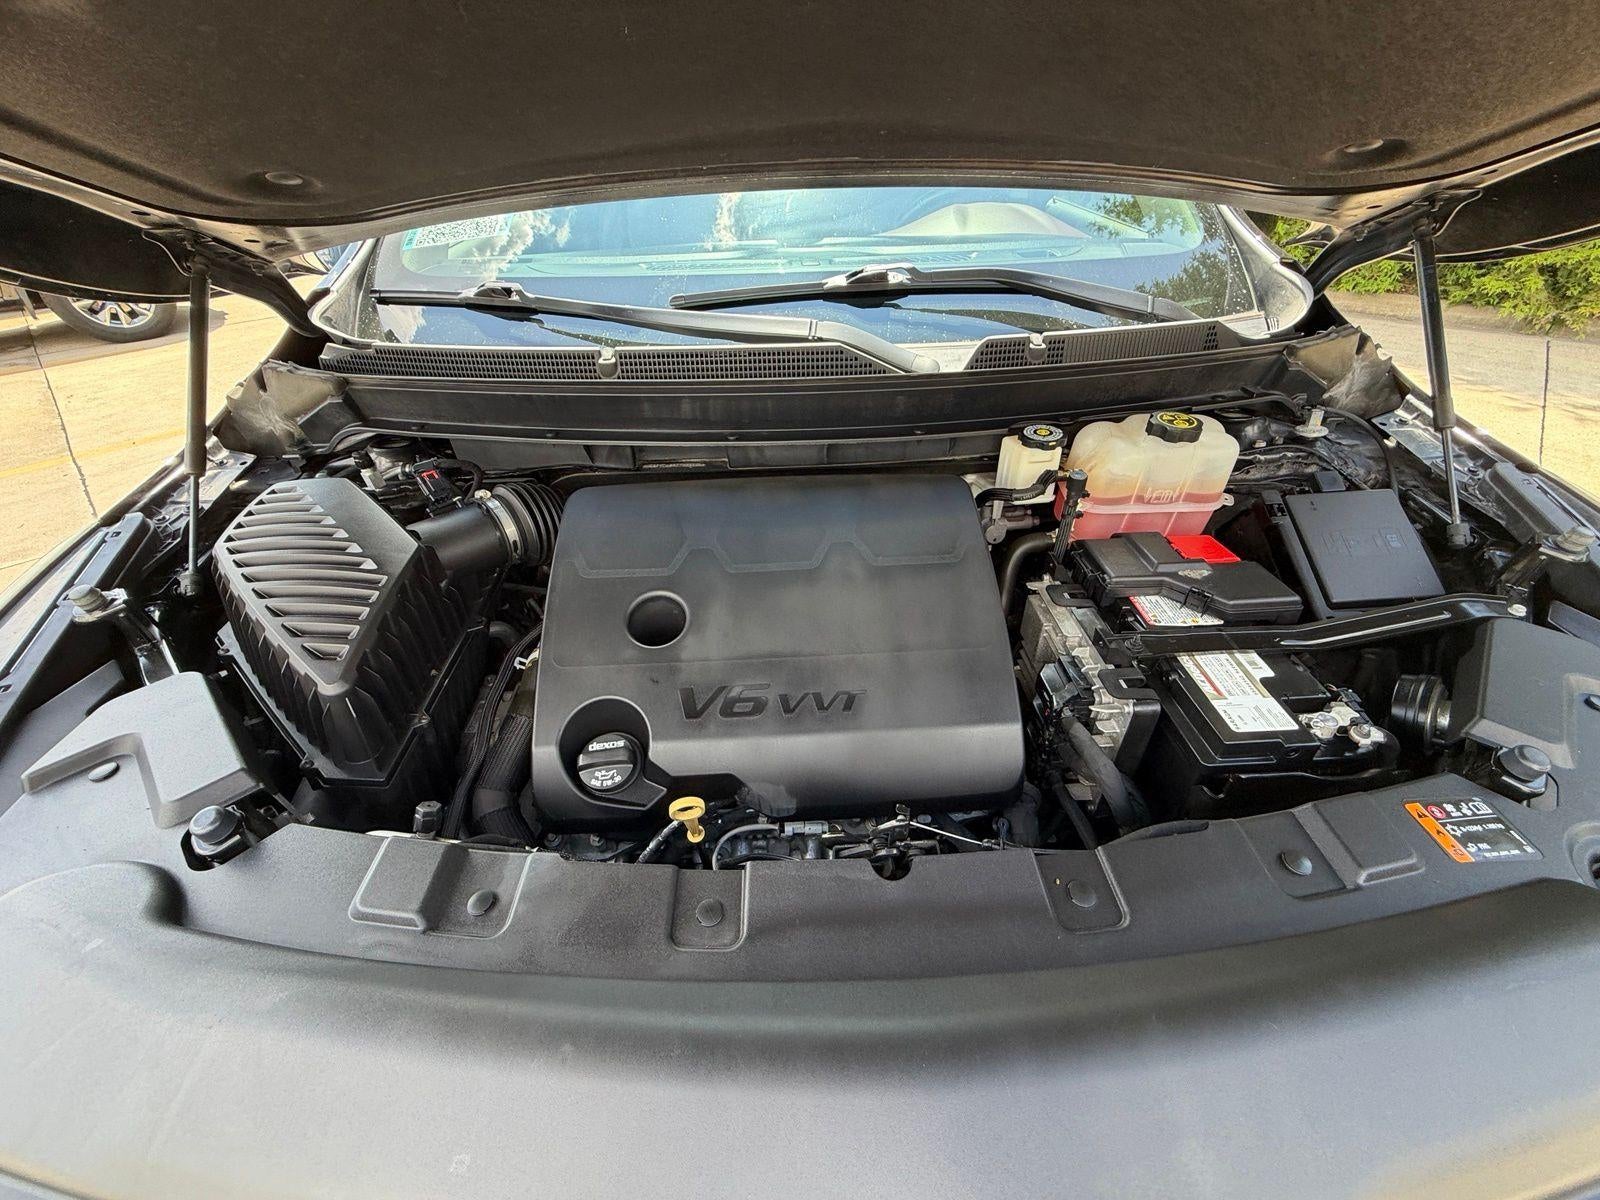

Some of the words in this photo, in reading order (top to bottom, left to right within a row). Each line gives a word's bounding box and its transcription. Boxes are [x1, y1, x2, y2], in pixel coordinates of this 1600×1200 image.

[679, 683, 771, 720] V6
[778, 689, 867, 716] VVT
[588, 740, 626, 751] dexos
